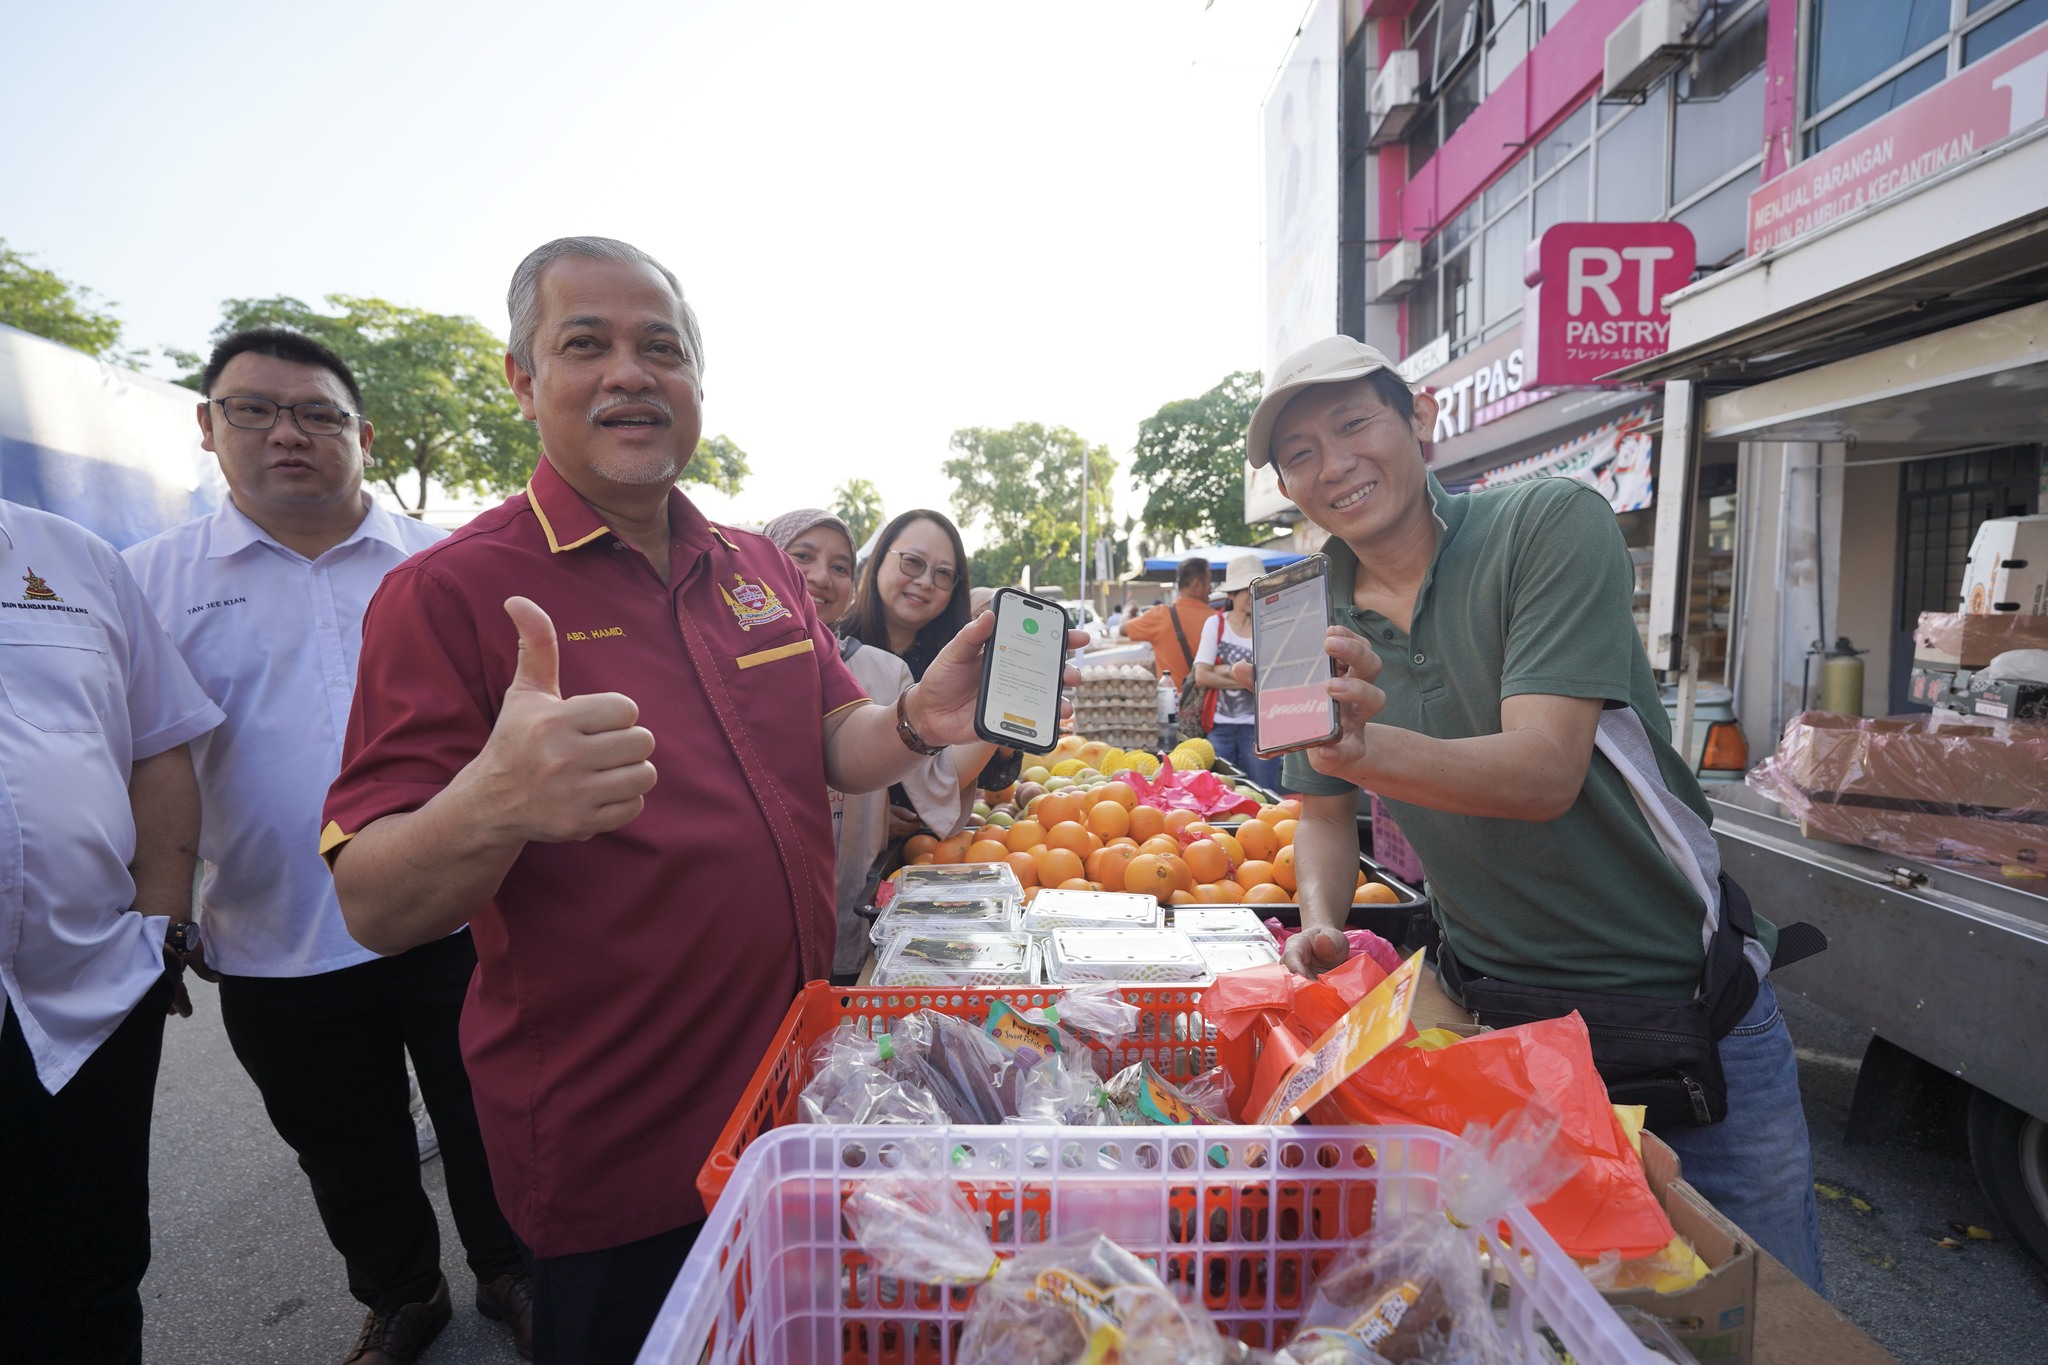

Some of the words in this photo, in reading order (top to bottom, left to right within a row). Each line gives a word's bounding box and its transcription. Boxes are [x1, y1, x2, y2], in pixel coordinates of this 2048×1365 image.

[1868, 129, 1975, 203] KECANTIKAN
[1755, 183, 1811, 231] MENJUAL
[1813, 136, 1894, 200] BARANGAN
[1567, 246, 1675, 317] RT
[1566, 321, 1670, 345] PASTRY
[18, 603, 47, 611] BANDAR
[187, 605, 204, 615] TAN
[206, 600, 221, 609] JEE
[223, 597, 246, 606] KIAN
[1012, 1018, 1041, 1037] Purple
[1005, 1030, 1023, 1040] Sweet
[1023, 1034, 1042, 1049] Potato
